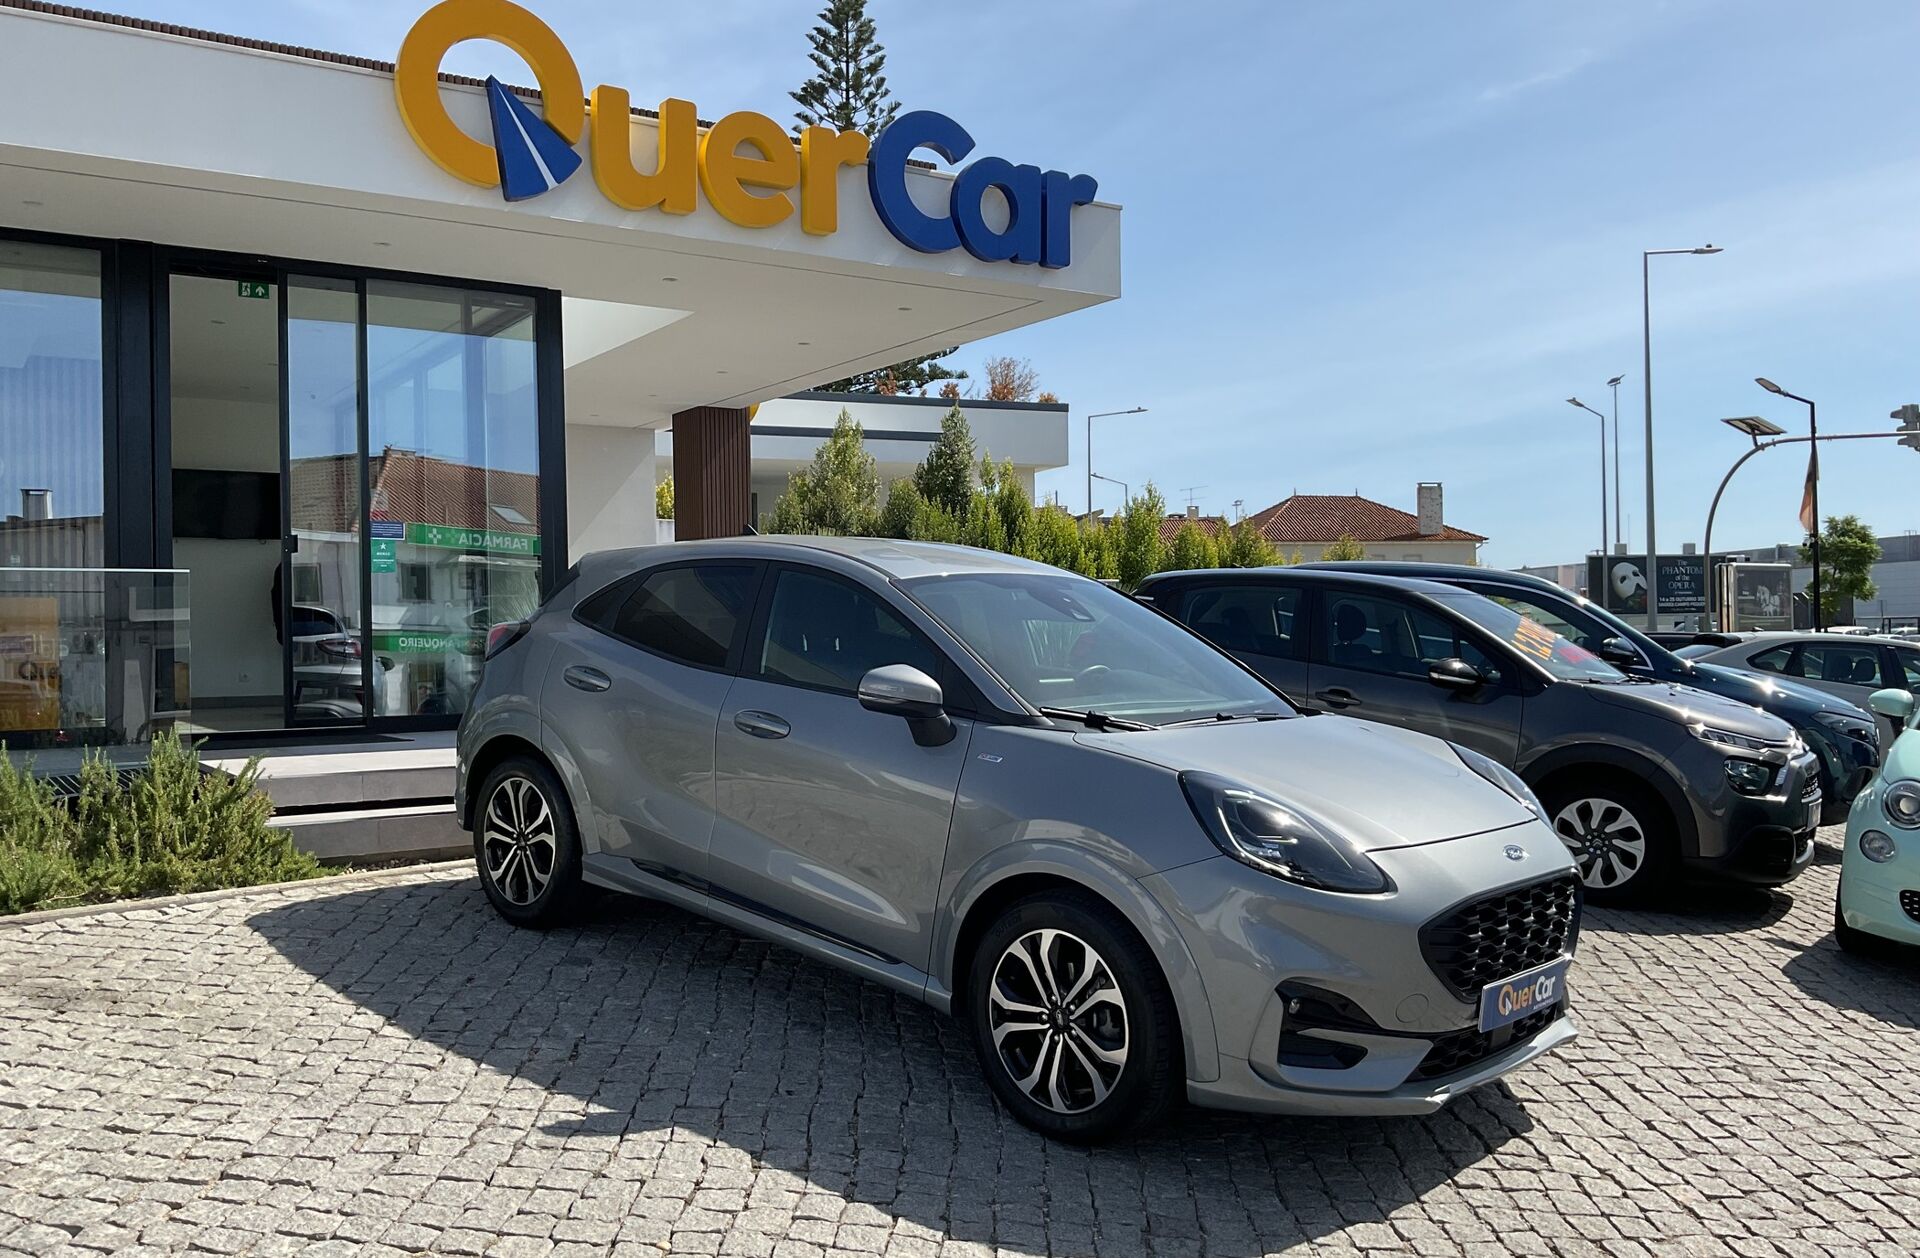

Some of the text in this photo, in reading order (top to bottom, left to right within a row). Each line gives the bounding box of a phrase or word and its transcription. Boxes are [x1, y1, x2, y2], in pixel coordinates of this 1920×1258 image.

[395, 0, 1098, 269] QuerCar
[1662, 566, 1703, 575] PHANTOM
[1668, 581, 1696, 589] OPERA
[1498, 976, 1556, 1016] QuerCar
